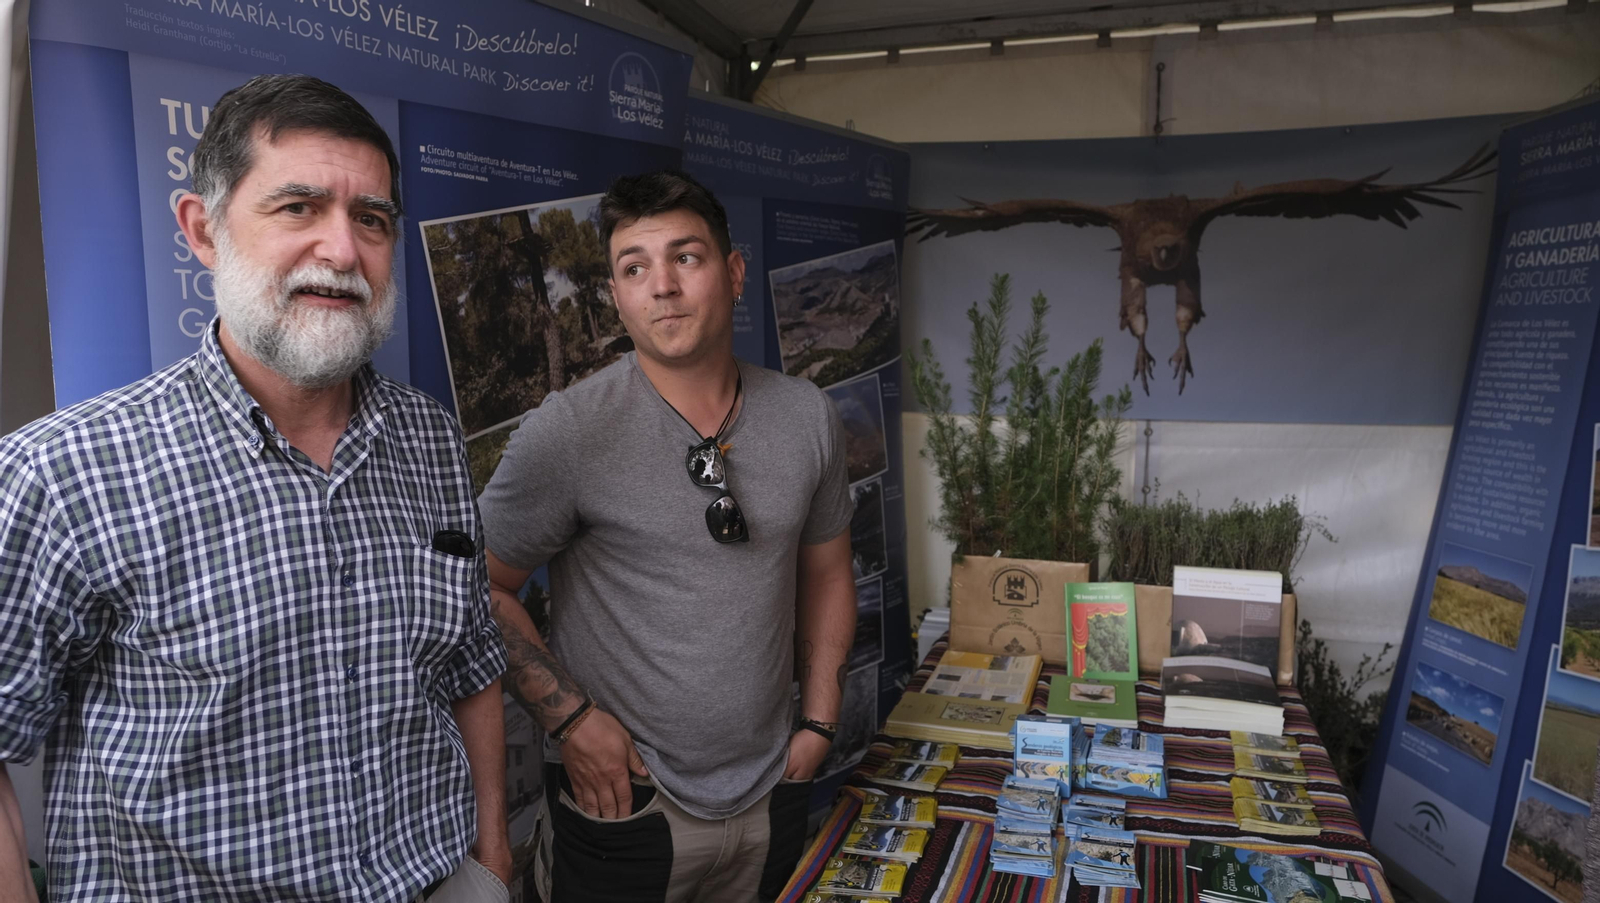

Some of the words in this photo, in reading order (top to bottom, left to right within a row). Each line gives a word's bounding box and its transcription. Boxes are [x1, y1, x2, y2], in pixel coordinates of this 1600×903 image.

[124, 3, 174, 24] Traducción
[177, 17, 204, 32] textos
[125, 17, 150, 32] Heidi
[153, 24, 197, 43] Grantham
[379, 4, 439, 41] VÉLEZ
[455, 24, 578, 55] ¡Descúbrelo!
[210, 0, 324, 41] MARÍA-LOS
[331, 26, 382, 56] VÉLEZ
[387, 41, 458, 76] NATURAL
[463, 62, 497, 86] PARK
[503, 71, 571, 92] Discover
[577, 74, 595, 92] it!
[609, 90, 637, 108] Sierra
[617, 106, 636, 122] Los
[638, 110, 664, 129] Vélez
[692, 115, 730, 135] NATURAL
[695, 133, 753, 157] MARÍA-LOS
[755, 142, 783, 162] VÉLEZ
[1556, 130, 1600, 156] MARÍA-
[420, 154, 457, 169] Adventure
[458, 161, 479, 173] circuit
[480, 165, 487, 174] of
[523, 174, 532, 182] en
[533, 174, 544, 184] Los
[427, 144, 455, 158] Circuito
[457, 151, 499, 166] multiaventura
[500, 158, 508, 168] de
[509, 161, 542, 175] Aventura-T
[543, 167, 551, 175] en
[551, 168, 562, 178] Los
[1508, 220, 1600, 249] AGRICULTURA
[1504, 253, 1513, 269] Y
[1515, 240, 1600, 269] GANADERÍA
[1498, 266, 1590, 290] AGRICULTURE
[1495, 290, 1522, 307] AND
[1524, 286, 1594, 306] LIVESTOCK
